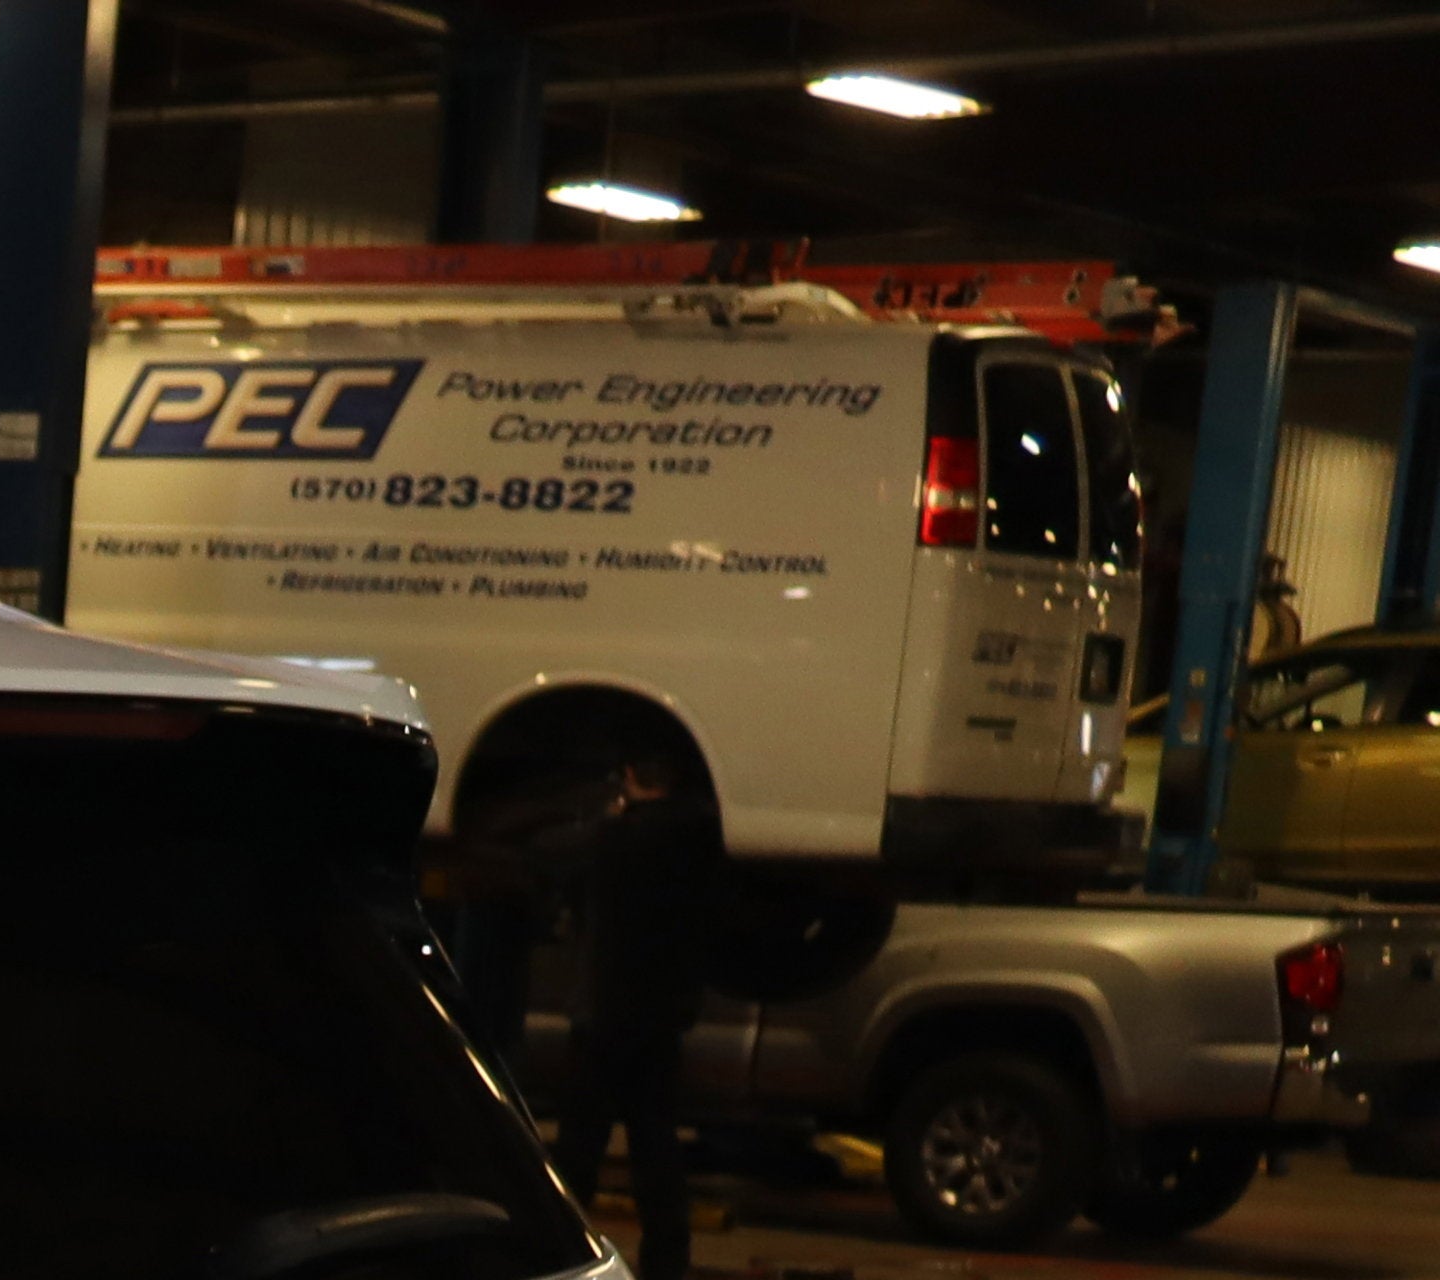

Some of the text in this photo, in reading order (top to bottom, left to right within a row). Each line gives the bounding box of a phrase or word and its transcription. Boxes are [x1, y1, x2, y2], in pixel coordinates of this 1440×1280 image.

[110, 368, 397, 450] PEC
[437, 372, 883, 416] Power Engineering
[489, 412, 774, 448] Corporation
[561, 456, 635, 473] Since
[291, 472, 636, 514] (570) 823-8822
